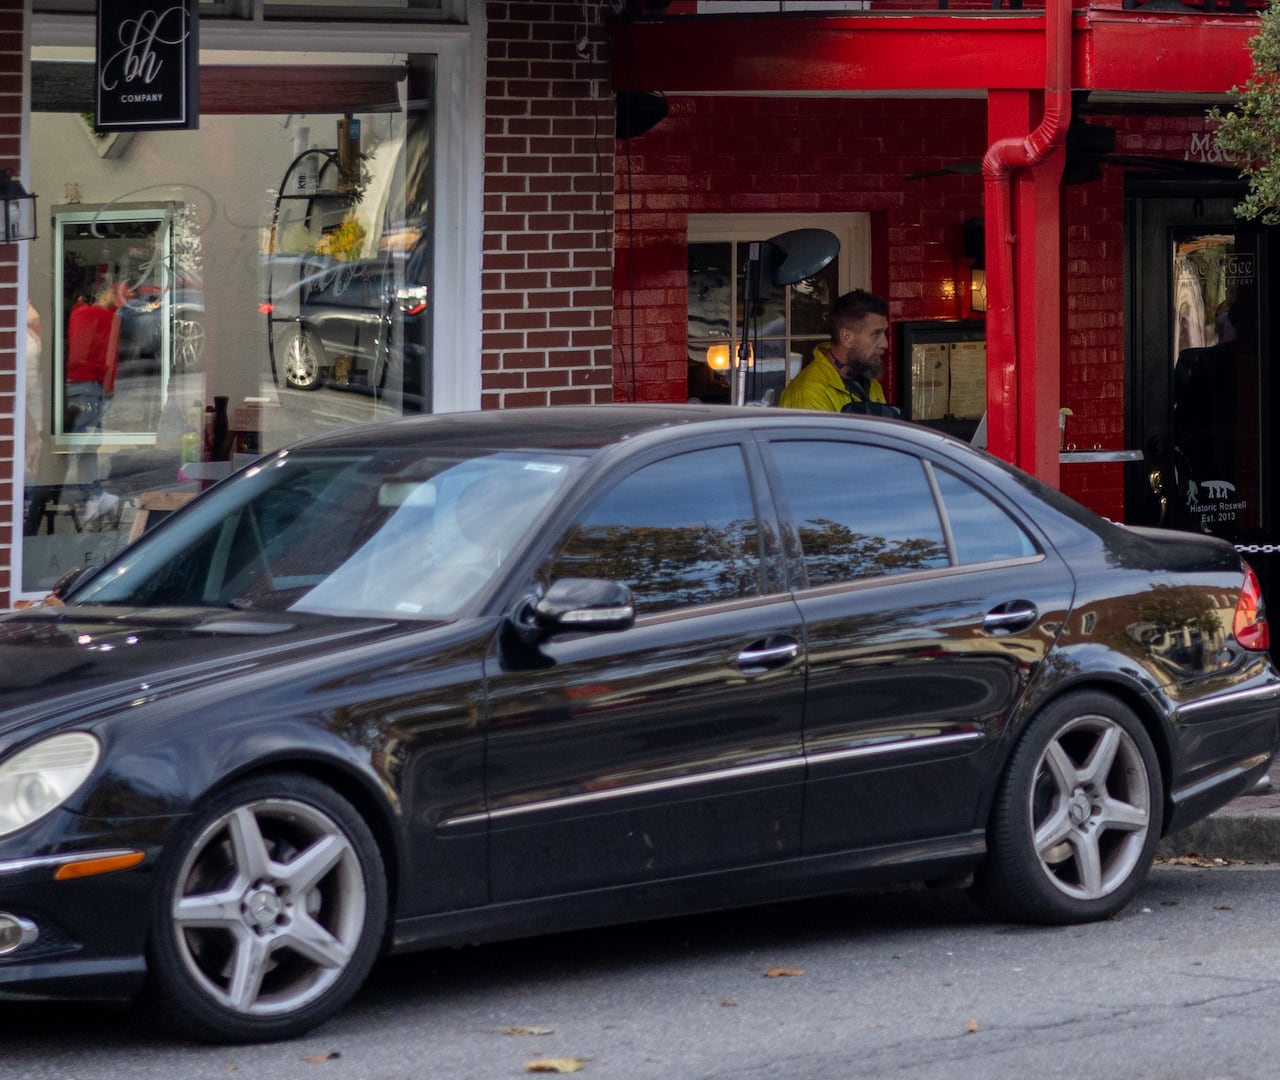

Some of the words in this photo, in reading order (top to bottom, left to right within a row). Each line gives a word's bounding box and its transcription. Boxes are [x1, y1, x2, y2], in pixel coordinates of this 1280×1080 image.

[120, 93, 163, 103] COMPANY
[1190, 504, 1217, 513] Historic
[1219, 501, 1247, 511] Roswell
[1201, 514, 1215, 523] Est.
[1218, 512, 1236, 522] 2013
